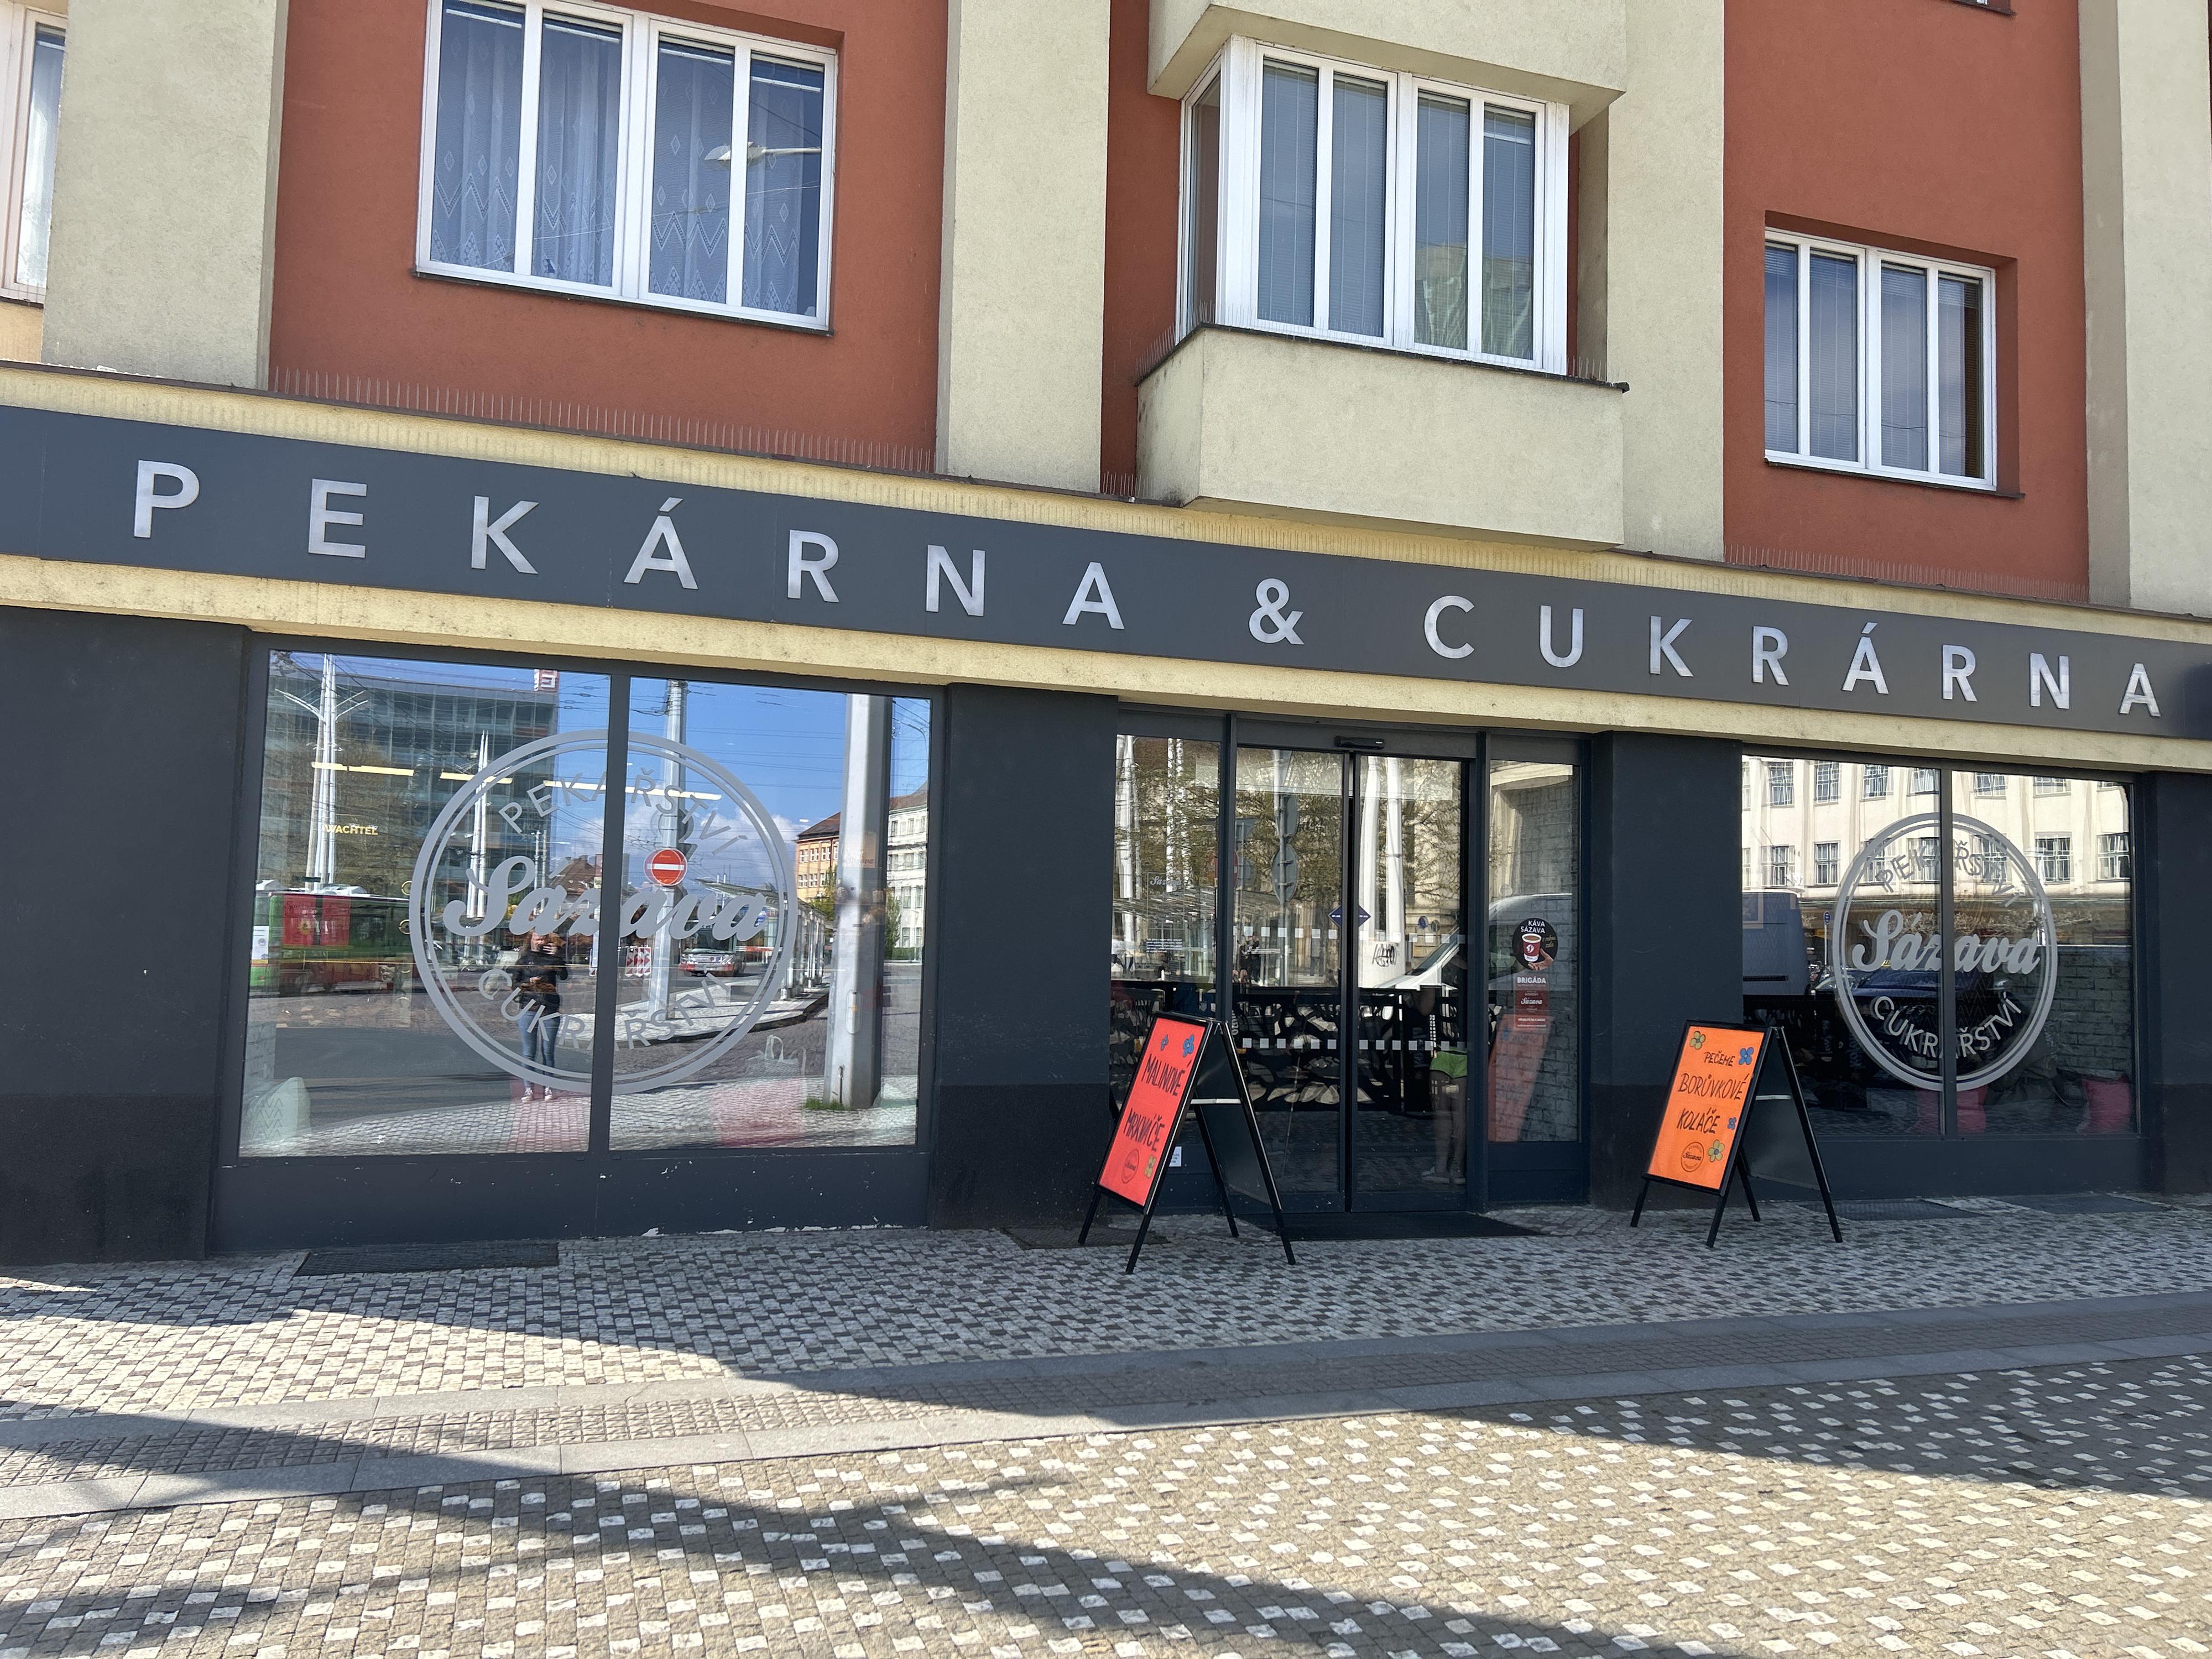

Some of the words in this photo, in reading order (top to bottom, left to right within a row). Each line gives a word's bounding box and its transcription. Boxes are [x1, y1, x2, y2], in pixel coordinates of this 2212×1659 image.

[134, 459, 1125, 630] PEKÁRNA
[1248, 578, 1305, 645] &
[1423, 595, 2160, 717] CUKRÁRNA
[325, 824, 378, 836] WACHTEL
[1876, 840, 2025, 907] PEKŘSTVÍ
[443, 855, 766, 941] Sázava
[1520, 926, 1546, 934] SÁZAVA
[1852, 910, 2041, 974] Sázava
[1517, 976, 1547, 984] BRIGÁDA
[479, 965, 731, 1050] CUKRŘSTVÍ
[1874, 992, 2022, 1059] CUKRŘSTVÍ
[1141, 1053, 1192, 1097] MALINOVÉ
[1704, 1051, 1736, 1067] PEČEME
[1678, 1073, 1750, 1100] BORŮVKOVÉ
[1123, 1108, 1165, 1152] MRKVÁČE
[1677, 1107, 1720, 1134] KOLÁČE
